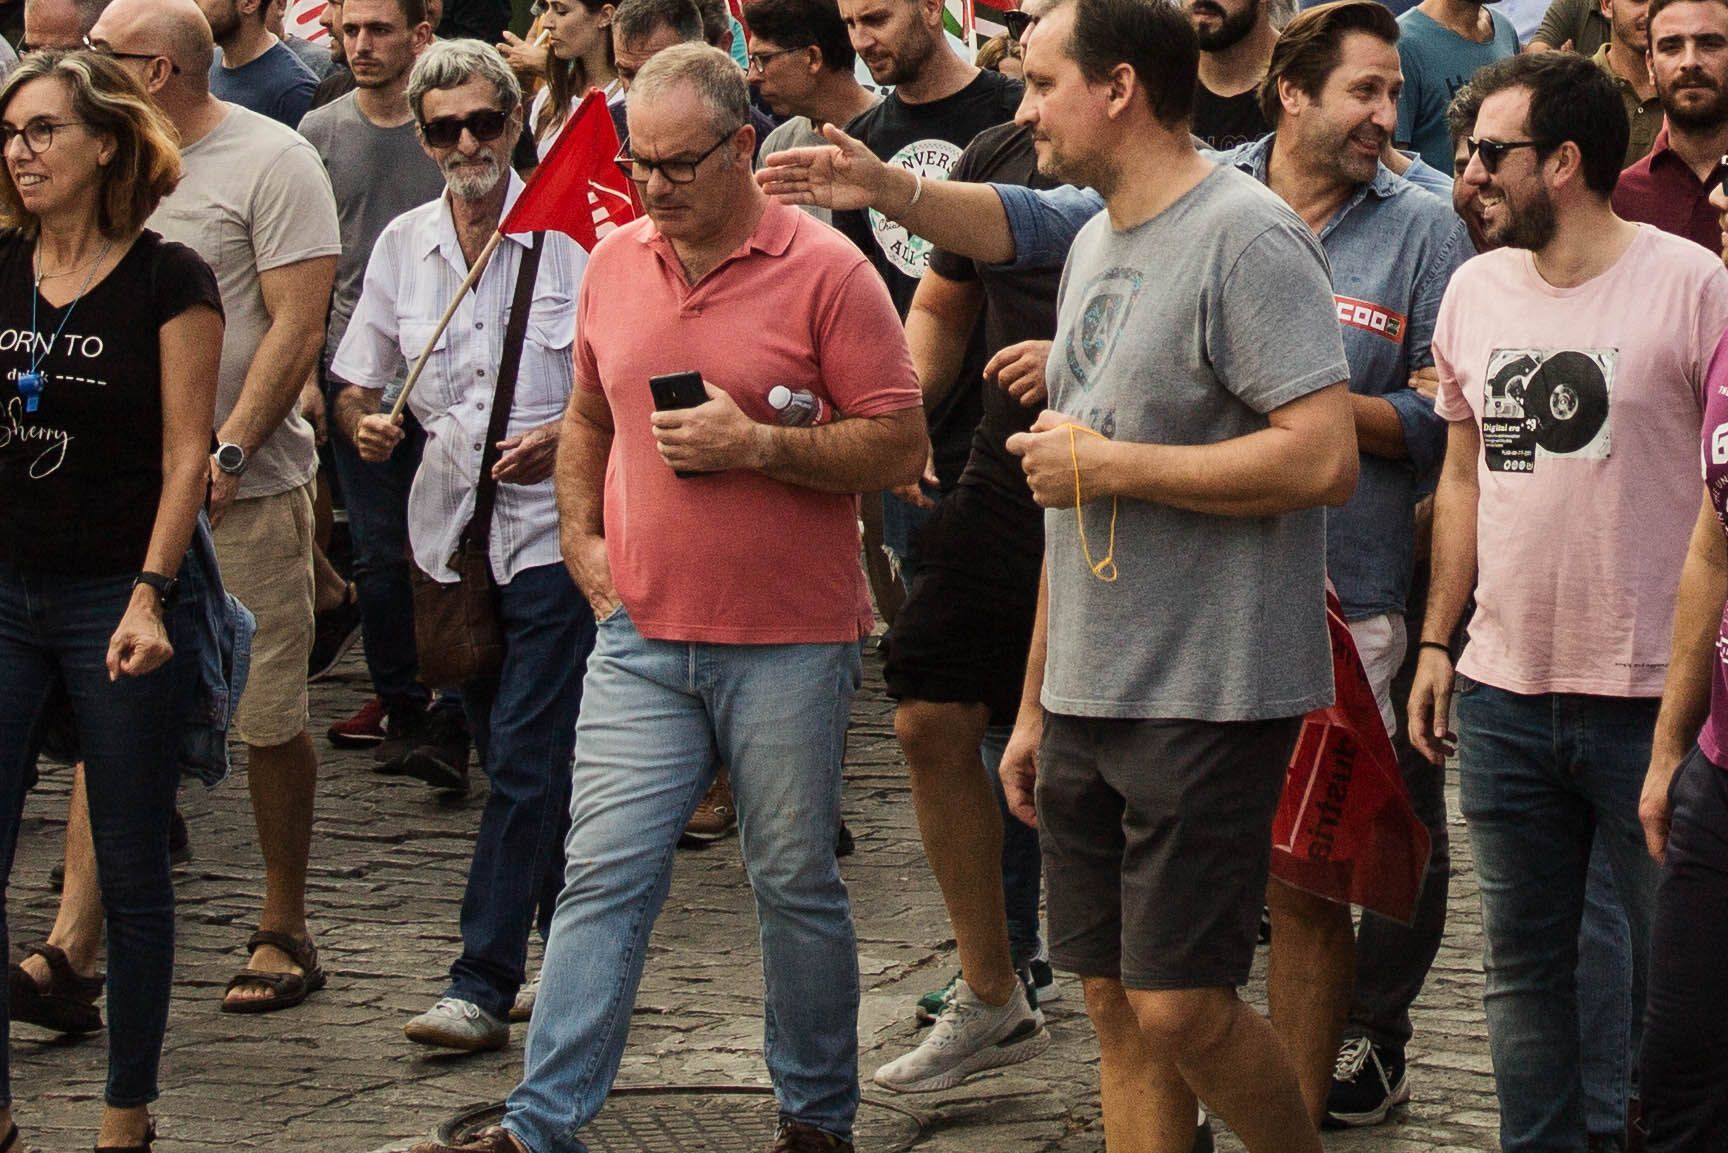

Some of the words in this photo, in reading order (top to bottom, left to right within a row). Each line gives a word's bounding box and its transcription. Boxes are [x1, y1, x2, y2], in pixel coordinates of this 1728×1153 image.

[890, 240, 916, 266] ALL
[0, 329, 55, 355] ORN
[64, 334, 103, 358] TO
